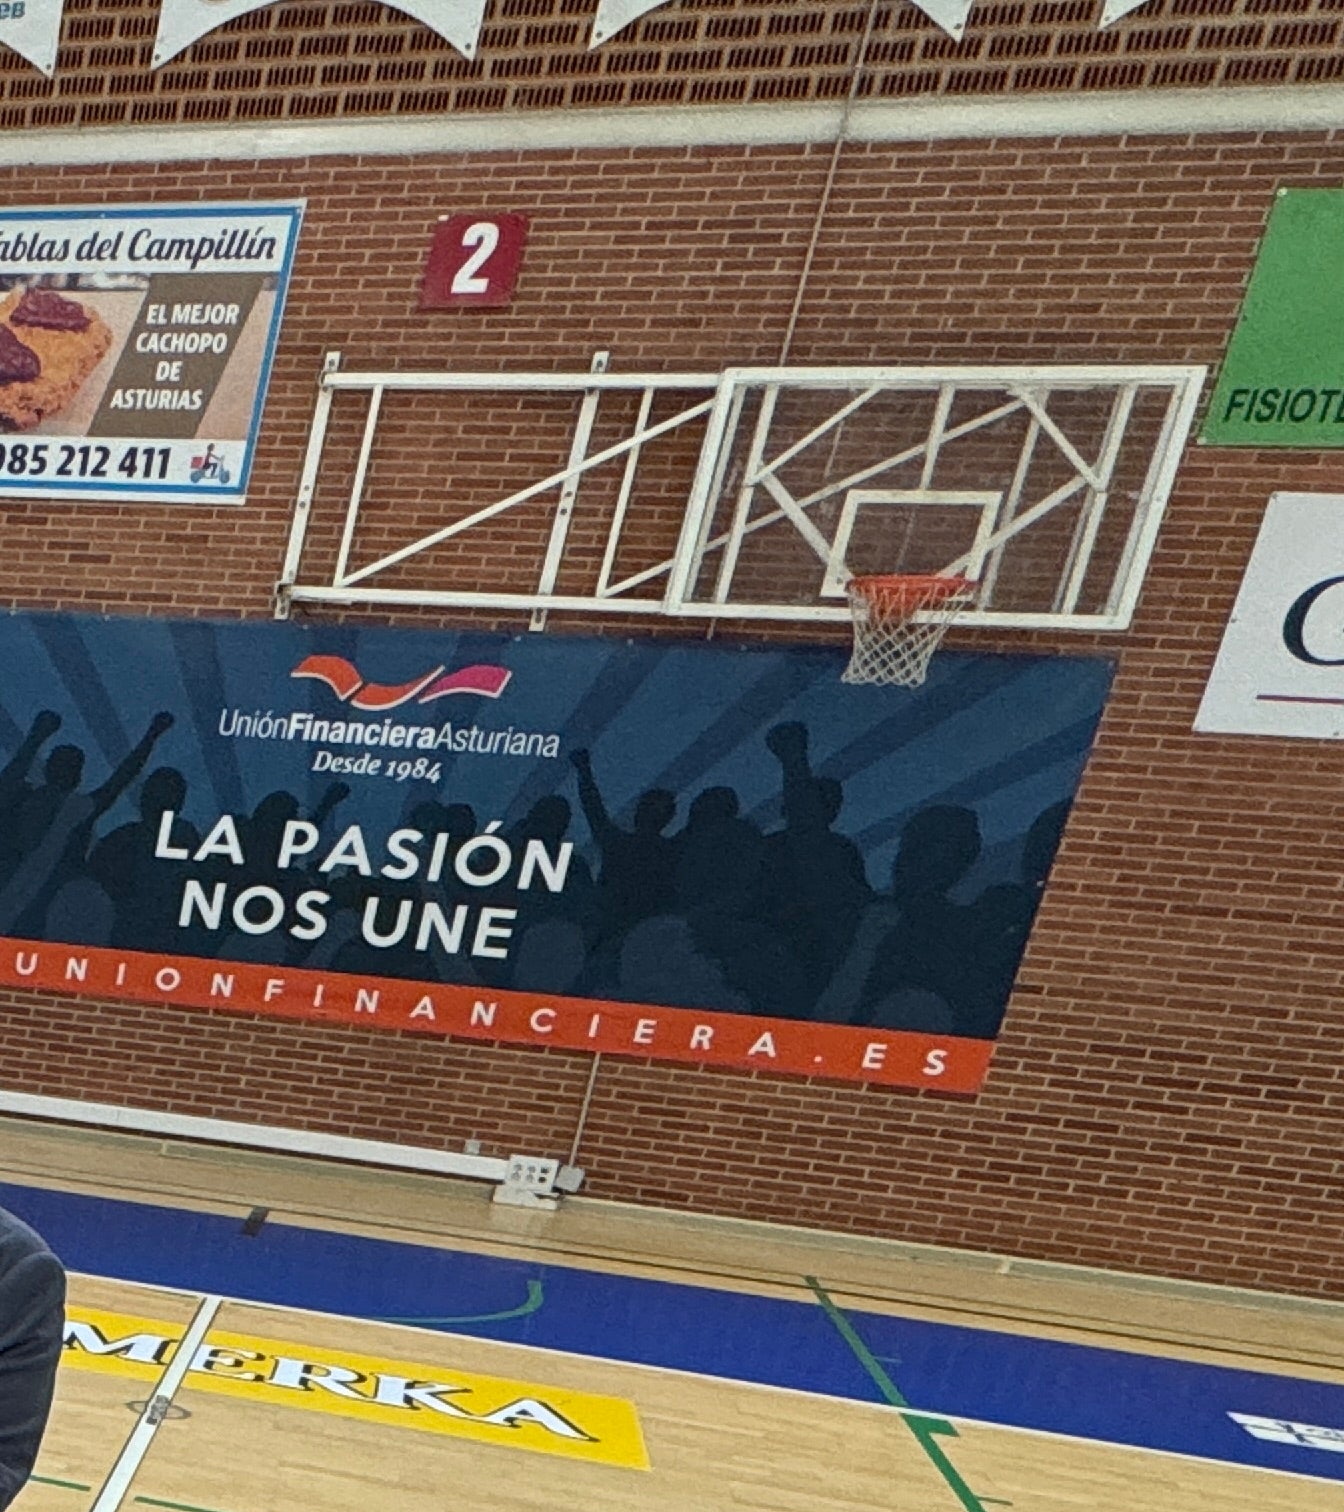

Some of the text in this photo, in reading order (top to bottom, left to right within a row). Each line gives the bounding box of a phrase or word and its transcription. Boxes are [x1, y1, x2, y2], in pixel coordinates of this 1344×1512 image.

[75, 229, 119, 262] del
[128, 226, 278, 270] Campillín
[450, 222, 498, 294] 2
[148, 303, 240, 325] EL MEJOR
[136, 331, 228, 354] CACHOPO
[156, 361, 180, 382] DE
[110, 388, 203, 411] ASTURIAS
[56, 444, 111, 478] 212
[118, 447, 171, 480] 411
[218, 708, 561, 760] UniónFinancieraAsturiana
[312, 750, 442, 784] Desde 1984
[155, 809, 574, 894] LA PASIÓN
[179, 880, 517, 961] NOS UNE
